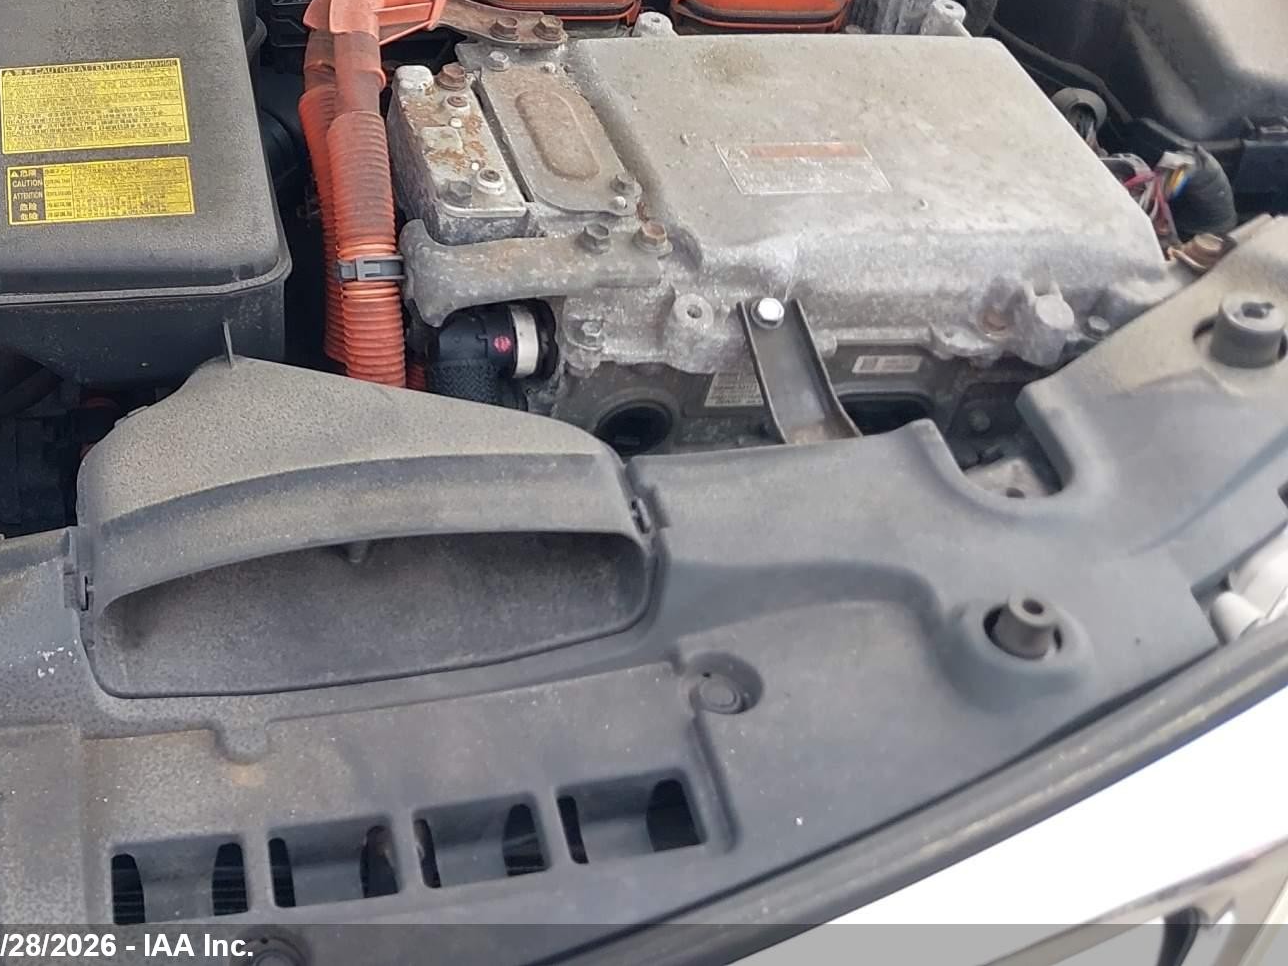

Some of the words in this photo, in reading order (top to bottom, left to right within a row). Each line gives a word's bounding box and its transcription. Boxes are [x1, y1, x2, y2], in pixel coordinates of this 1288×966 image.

[34, 65, 74, 75] CAUTION
[12, 179, 43, 188] CAUTION
[12, 191, 43, 202] ATTENTION
